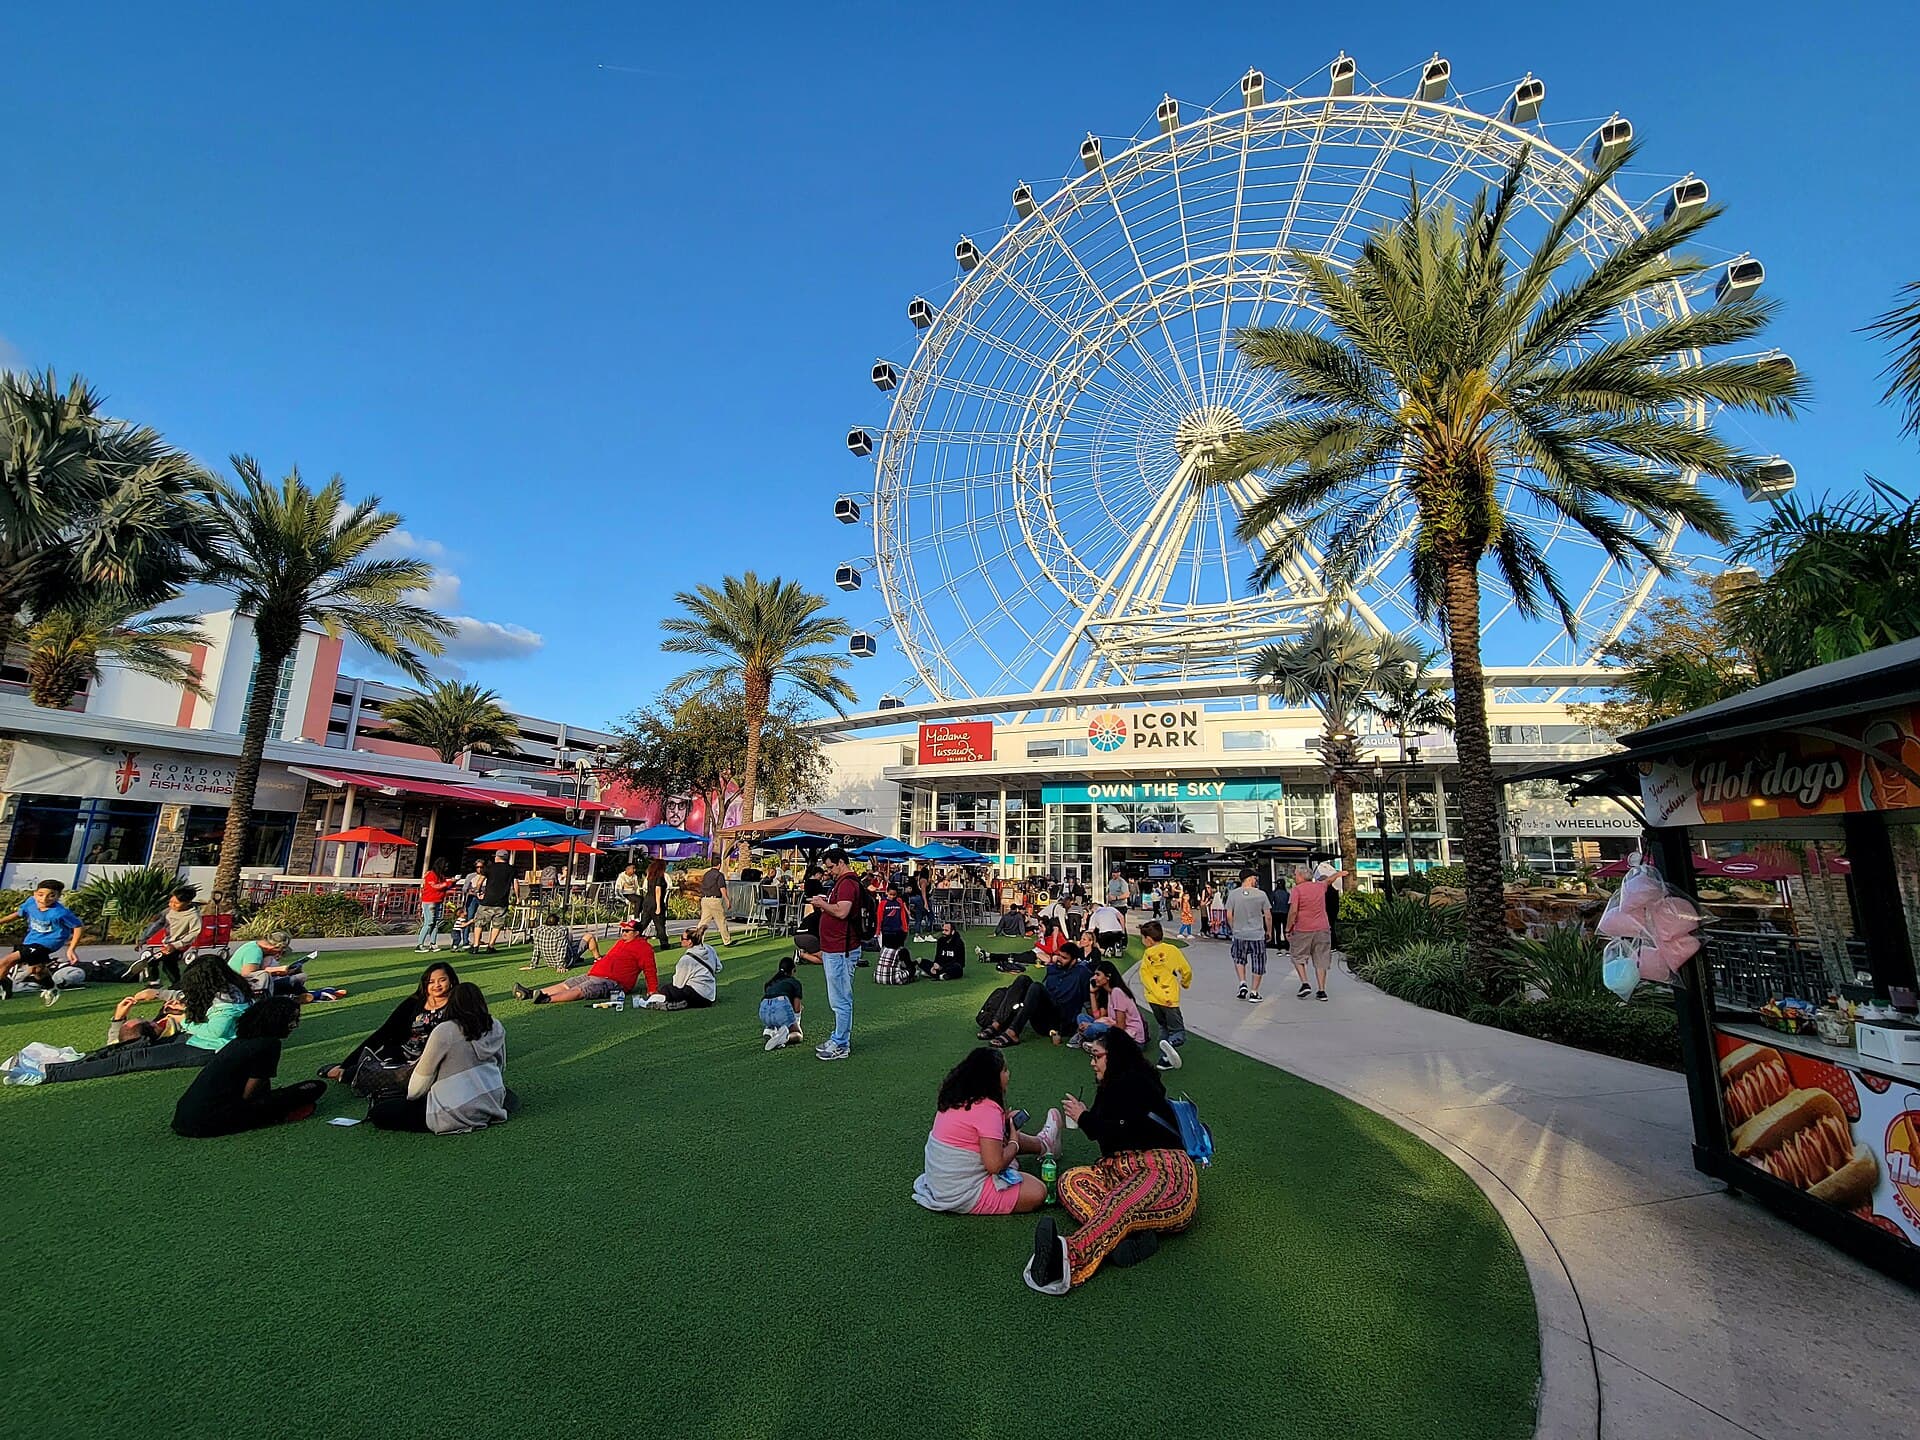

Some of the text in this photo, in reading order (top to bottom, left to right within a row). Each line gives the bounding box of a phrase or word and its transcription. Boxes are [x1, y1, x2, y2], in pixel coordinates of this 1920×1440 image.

[1133, 711, 1198, 730] ICON
[926, 726, 971, 743] Madame
[1134, 730, 1198, 749] PARK
[1365, 737, 1410, 746] AQUARI
[927, 740, 977, 762] Tussauds
[152, 772, 234, 786] RAMSAY
[153, 763, 236, 779] GORDON
[1700, 752, 1844, 804] Hot dogs
[149, 780, 233, 795] FISH & CHIPS
[1087, 781, 1226, 798] OWN THE SKY
[1555, 819, 1640, 829] WHEELHOUS
